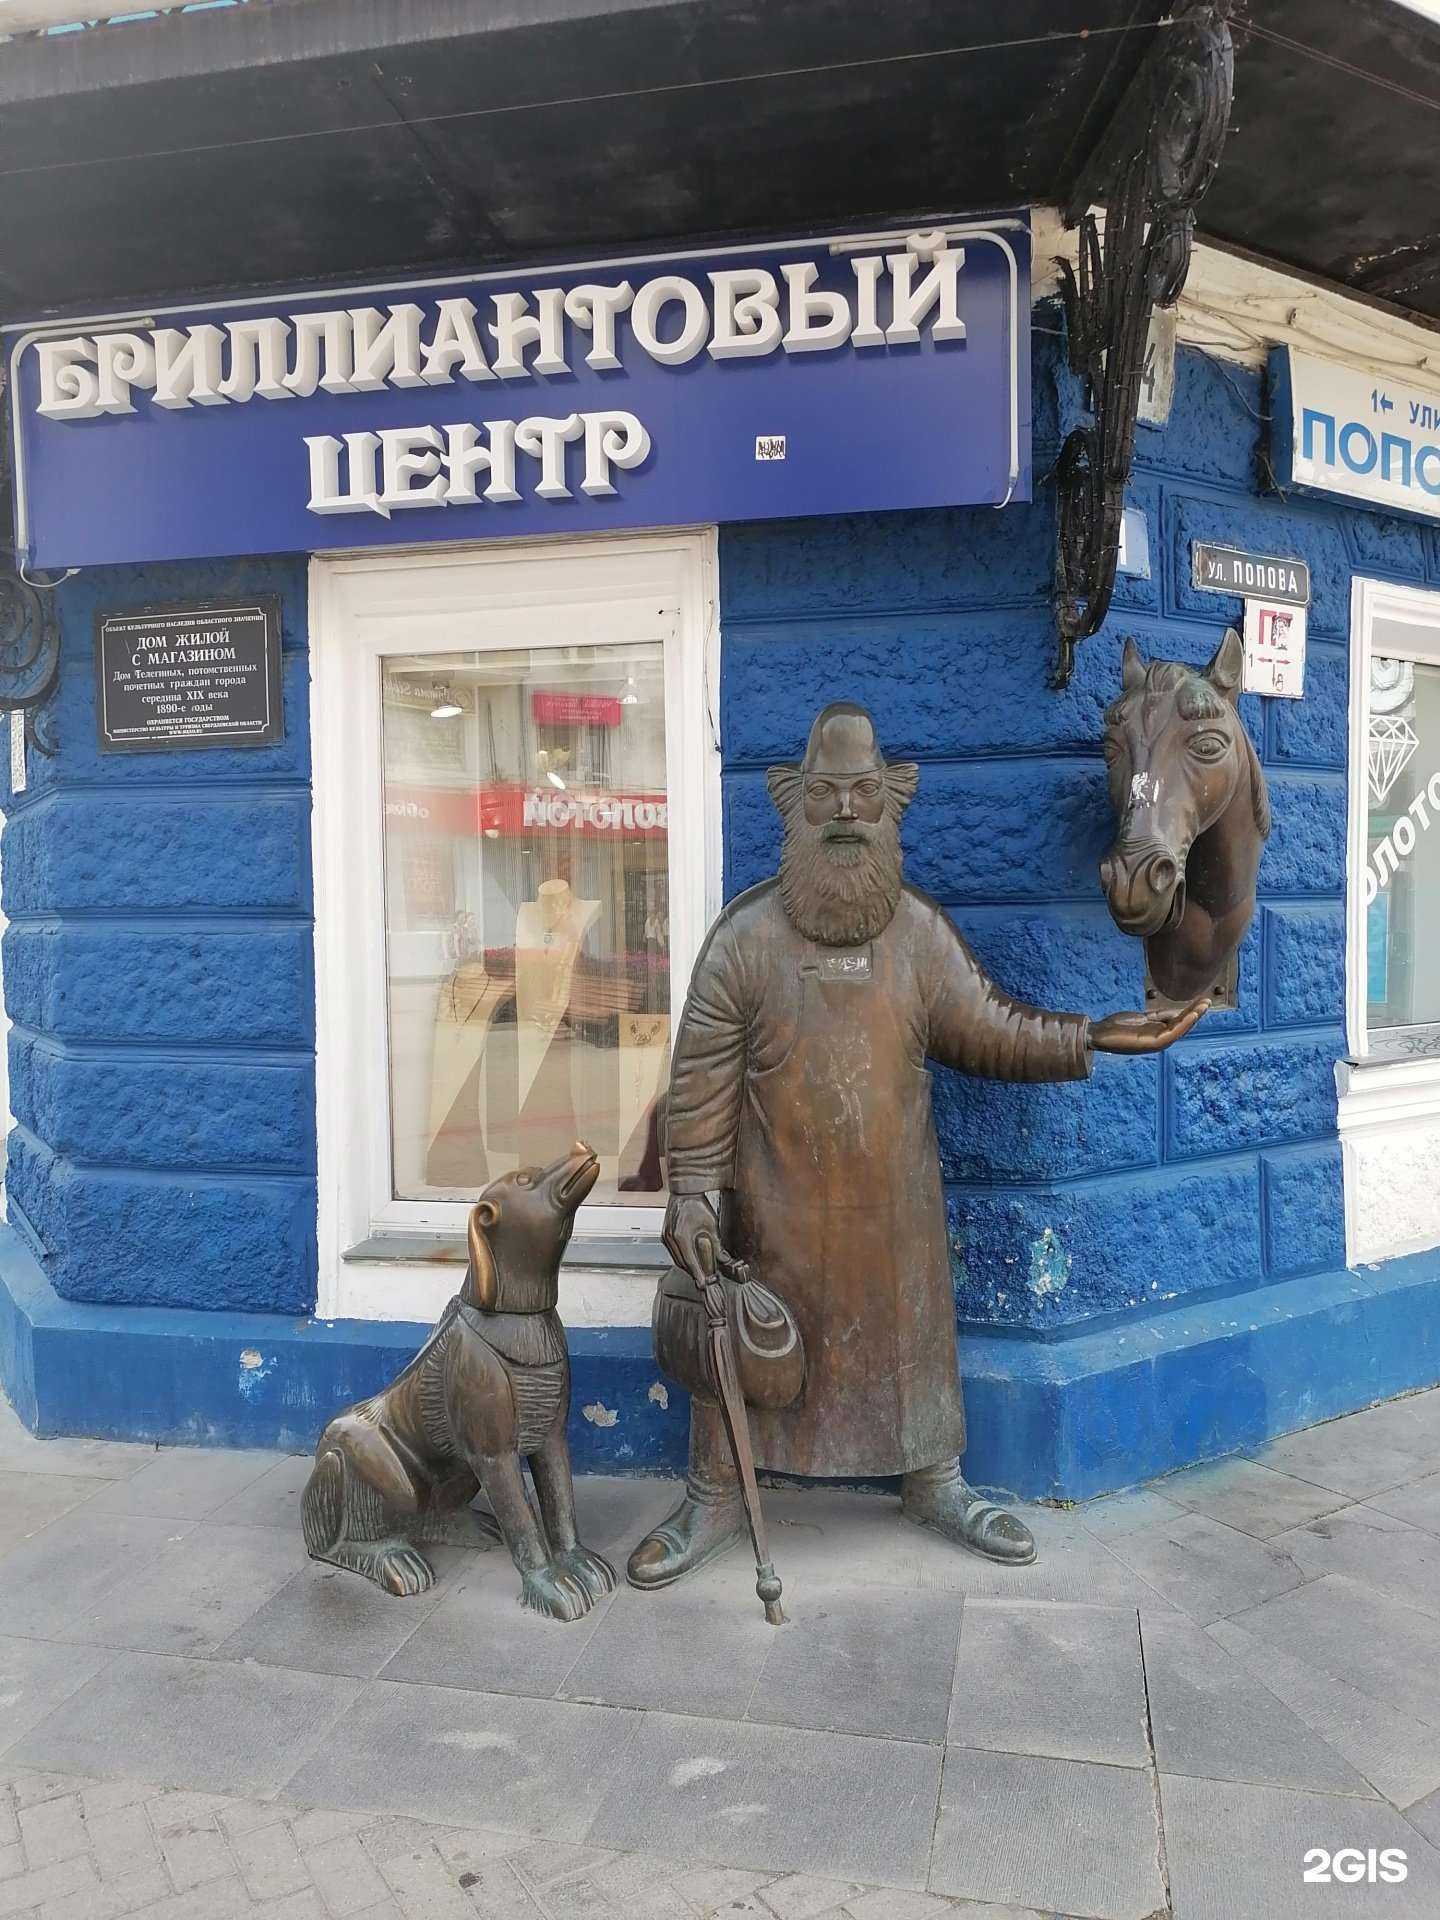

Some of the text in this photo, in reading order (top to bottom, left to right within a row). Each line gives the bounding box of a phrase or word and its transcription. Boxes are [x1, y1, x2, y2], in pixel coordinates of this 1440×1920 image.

[35, 230, 967, 420] БРИЛЛИАНТОВЫЙ
[303, 410, 651, 519] ЦЕНТР
[1233, 561, 1298, 593] ПОПОВА
[136, 627, 231, 651] ДОМ ЖИЛОЙ
[131, 647, 237, 666] С МАГАЗИНОМ
[112, 664, 258, 683] Дом Телегиных, потомственных
[123, 676, 247, 692] почетных граждан города
[141, 694, 182, 705] середина
[208, 691, 229, 699] века
